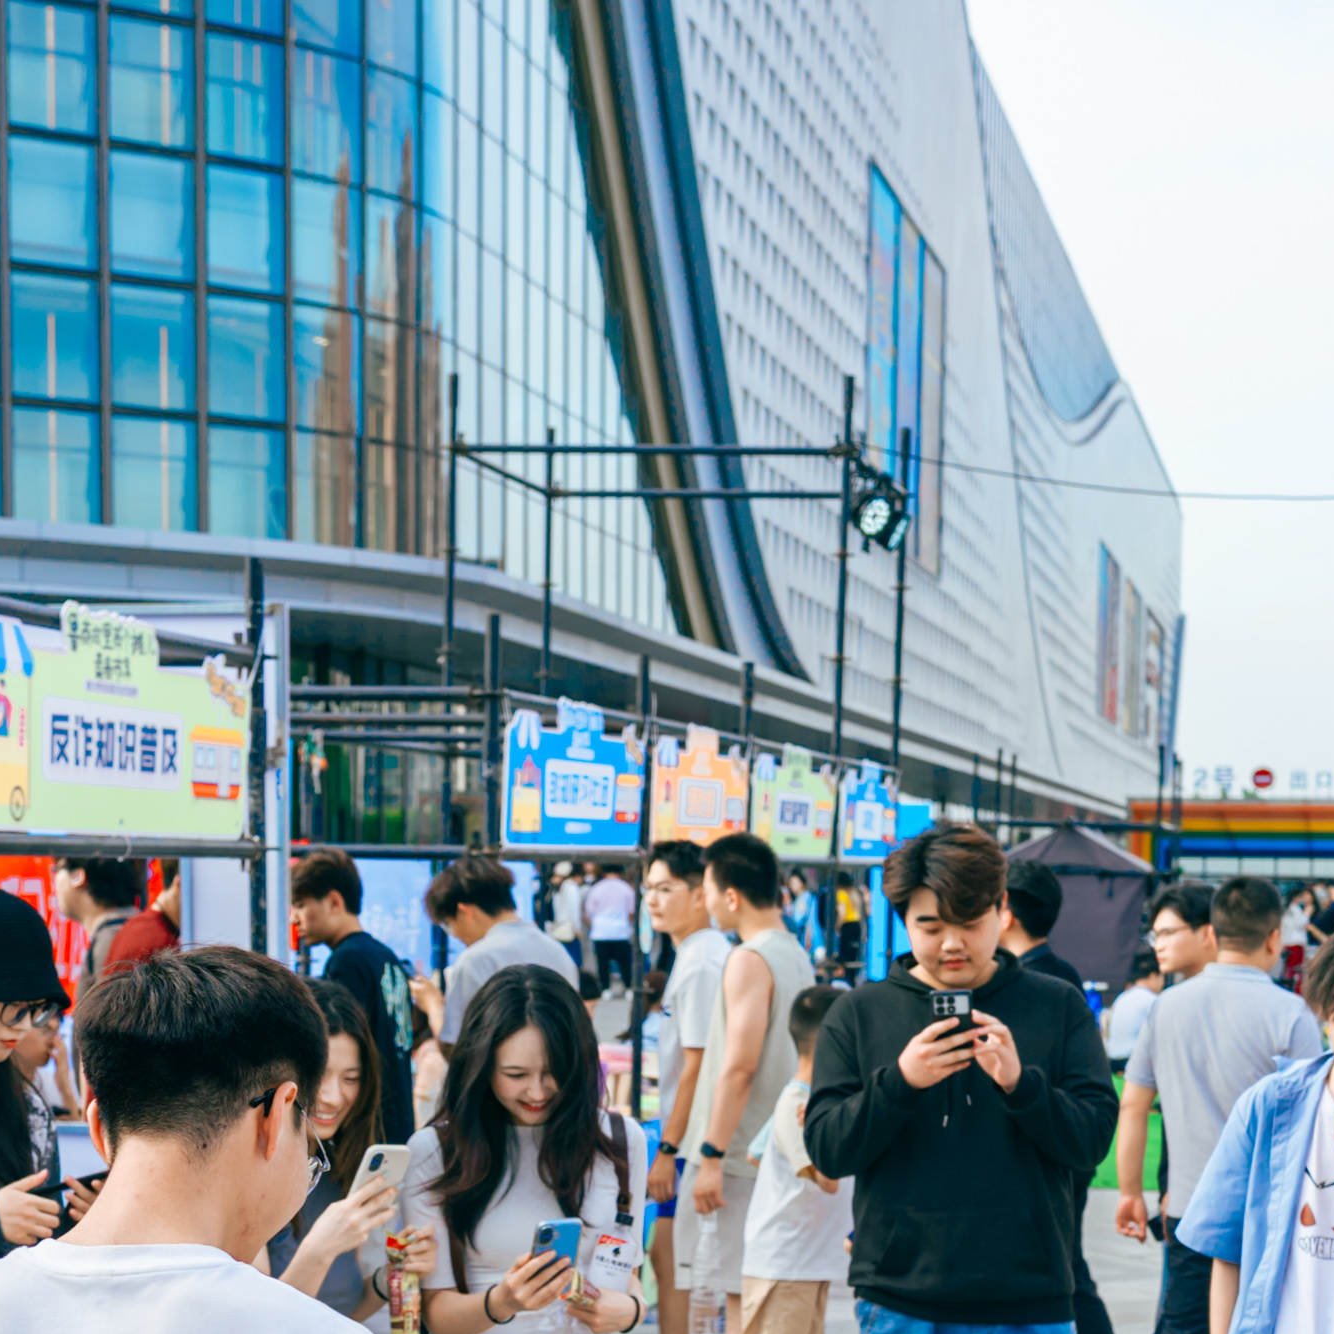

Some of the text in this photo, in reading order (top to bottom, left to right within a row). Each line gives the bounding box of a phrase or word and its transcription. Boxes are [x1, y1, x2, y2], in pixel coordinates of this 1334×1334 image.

[51, 714, 178, 775] 反诈知识普及
